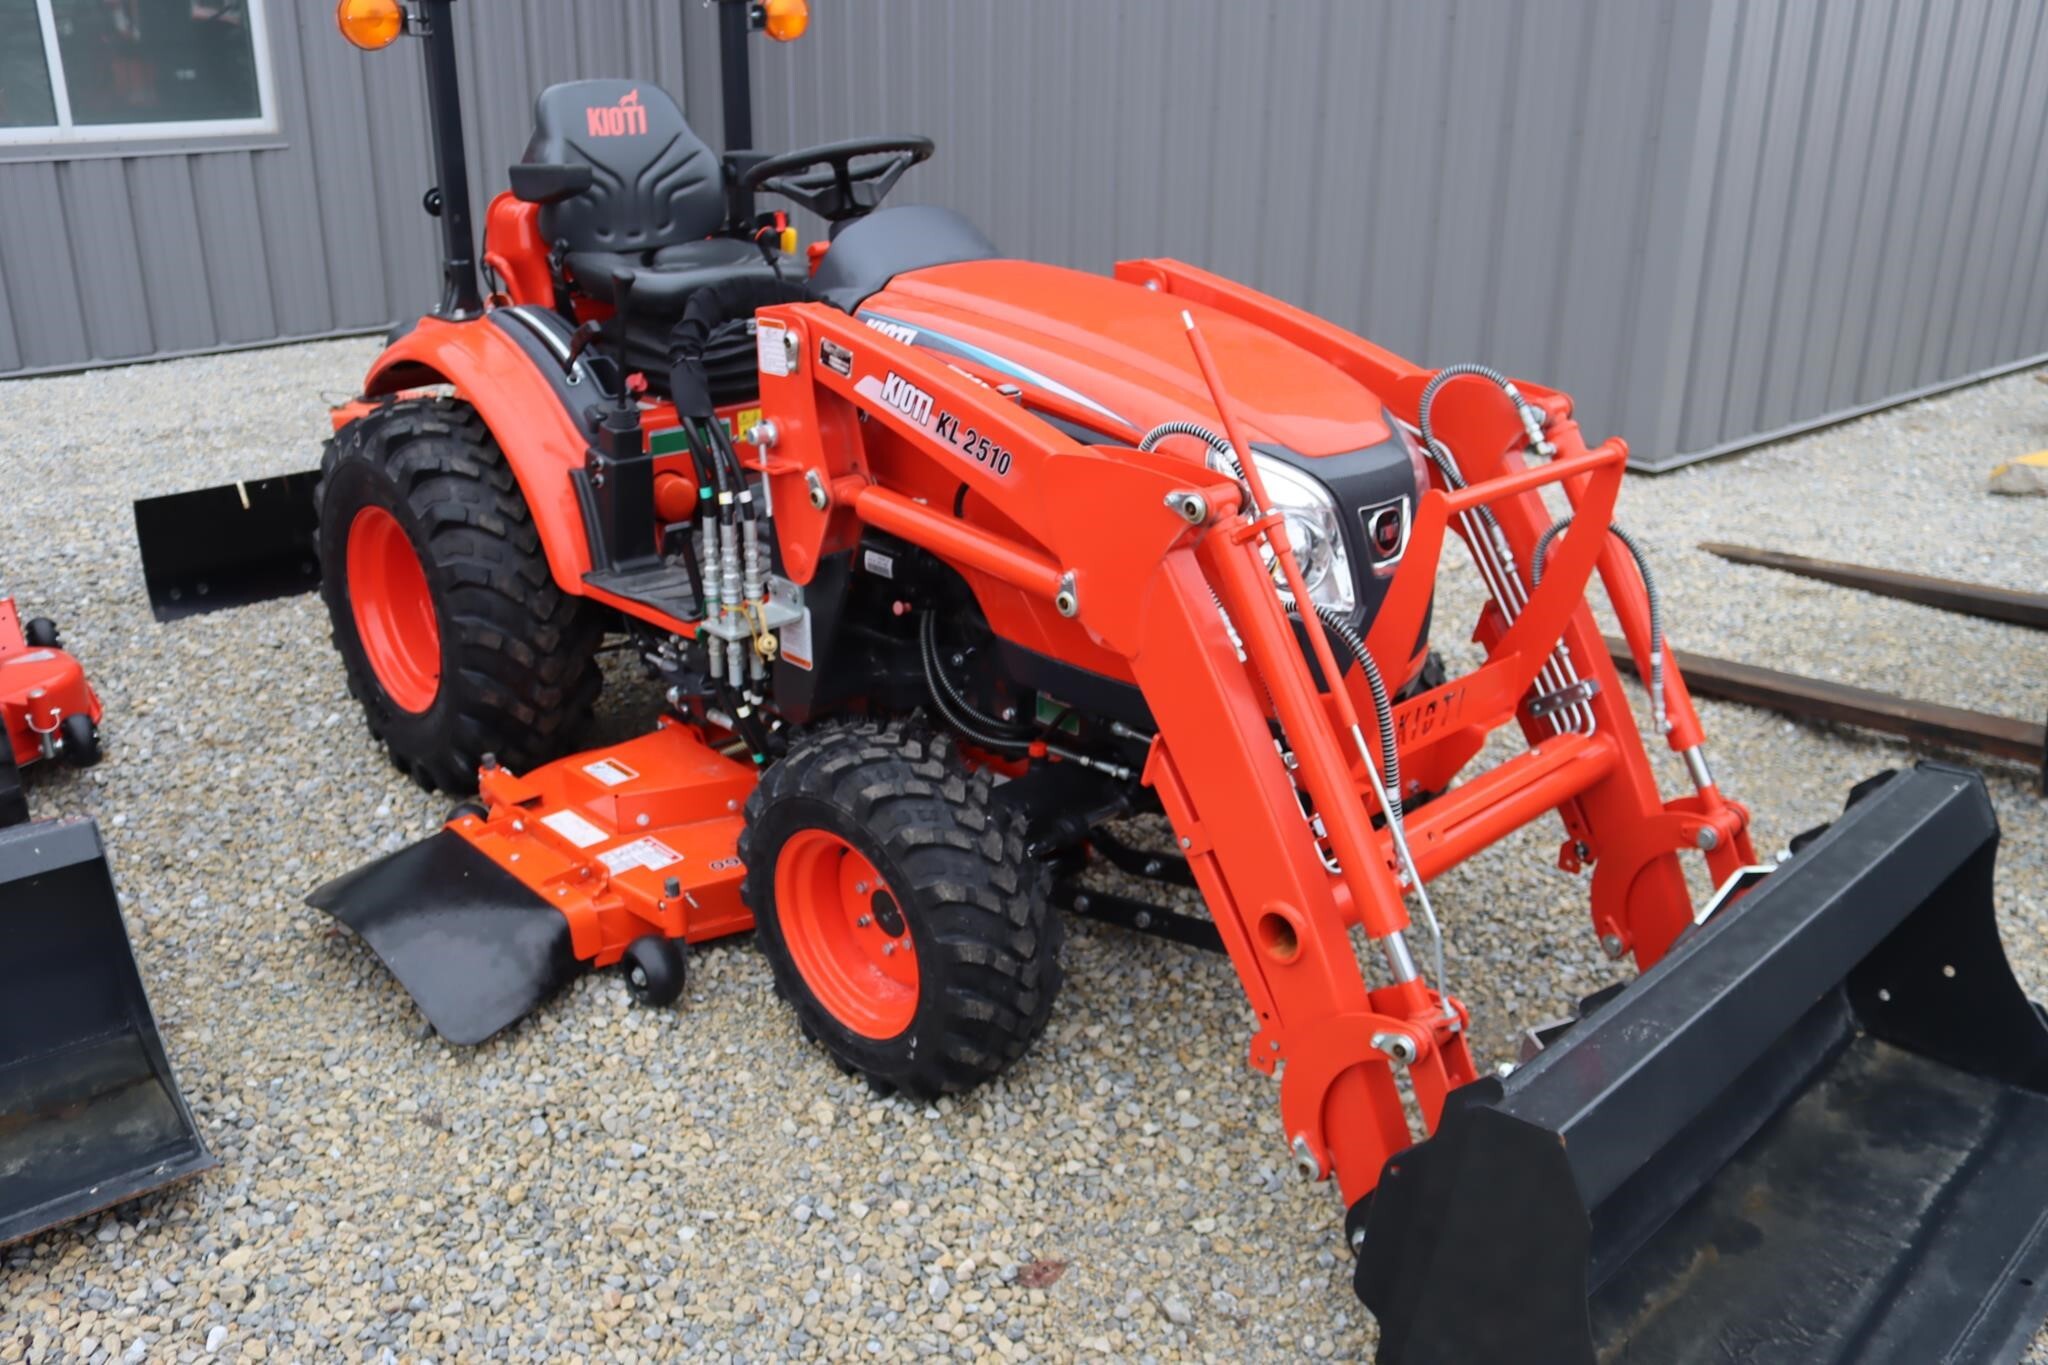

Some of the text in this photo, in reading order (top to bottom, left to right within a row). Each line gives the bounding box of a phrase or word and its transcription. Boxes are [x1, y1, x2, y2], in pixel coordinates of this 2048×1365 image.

[586, 105, 648, 137] KIOTI
[881, 370, 935, 426] KIOTI
[935, 411, 960, 445] KL
[963, 429, 1011, 476] 2510
[1398, 687, 1466, 745] KIOTI
